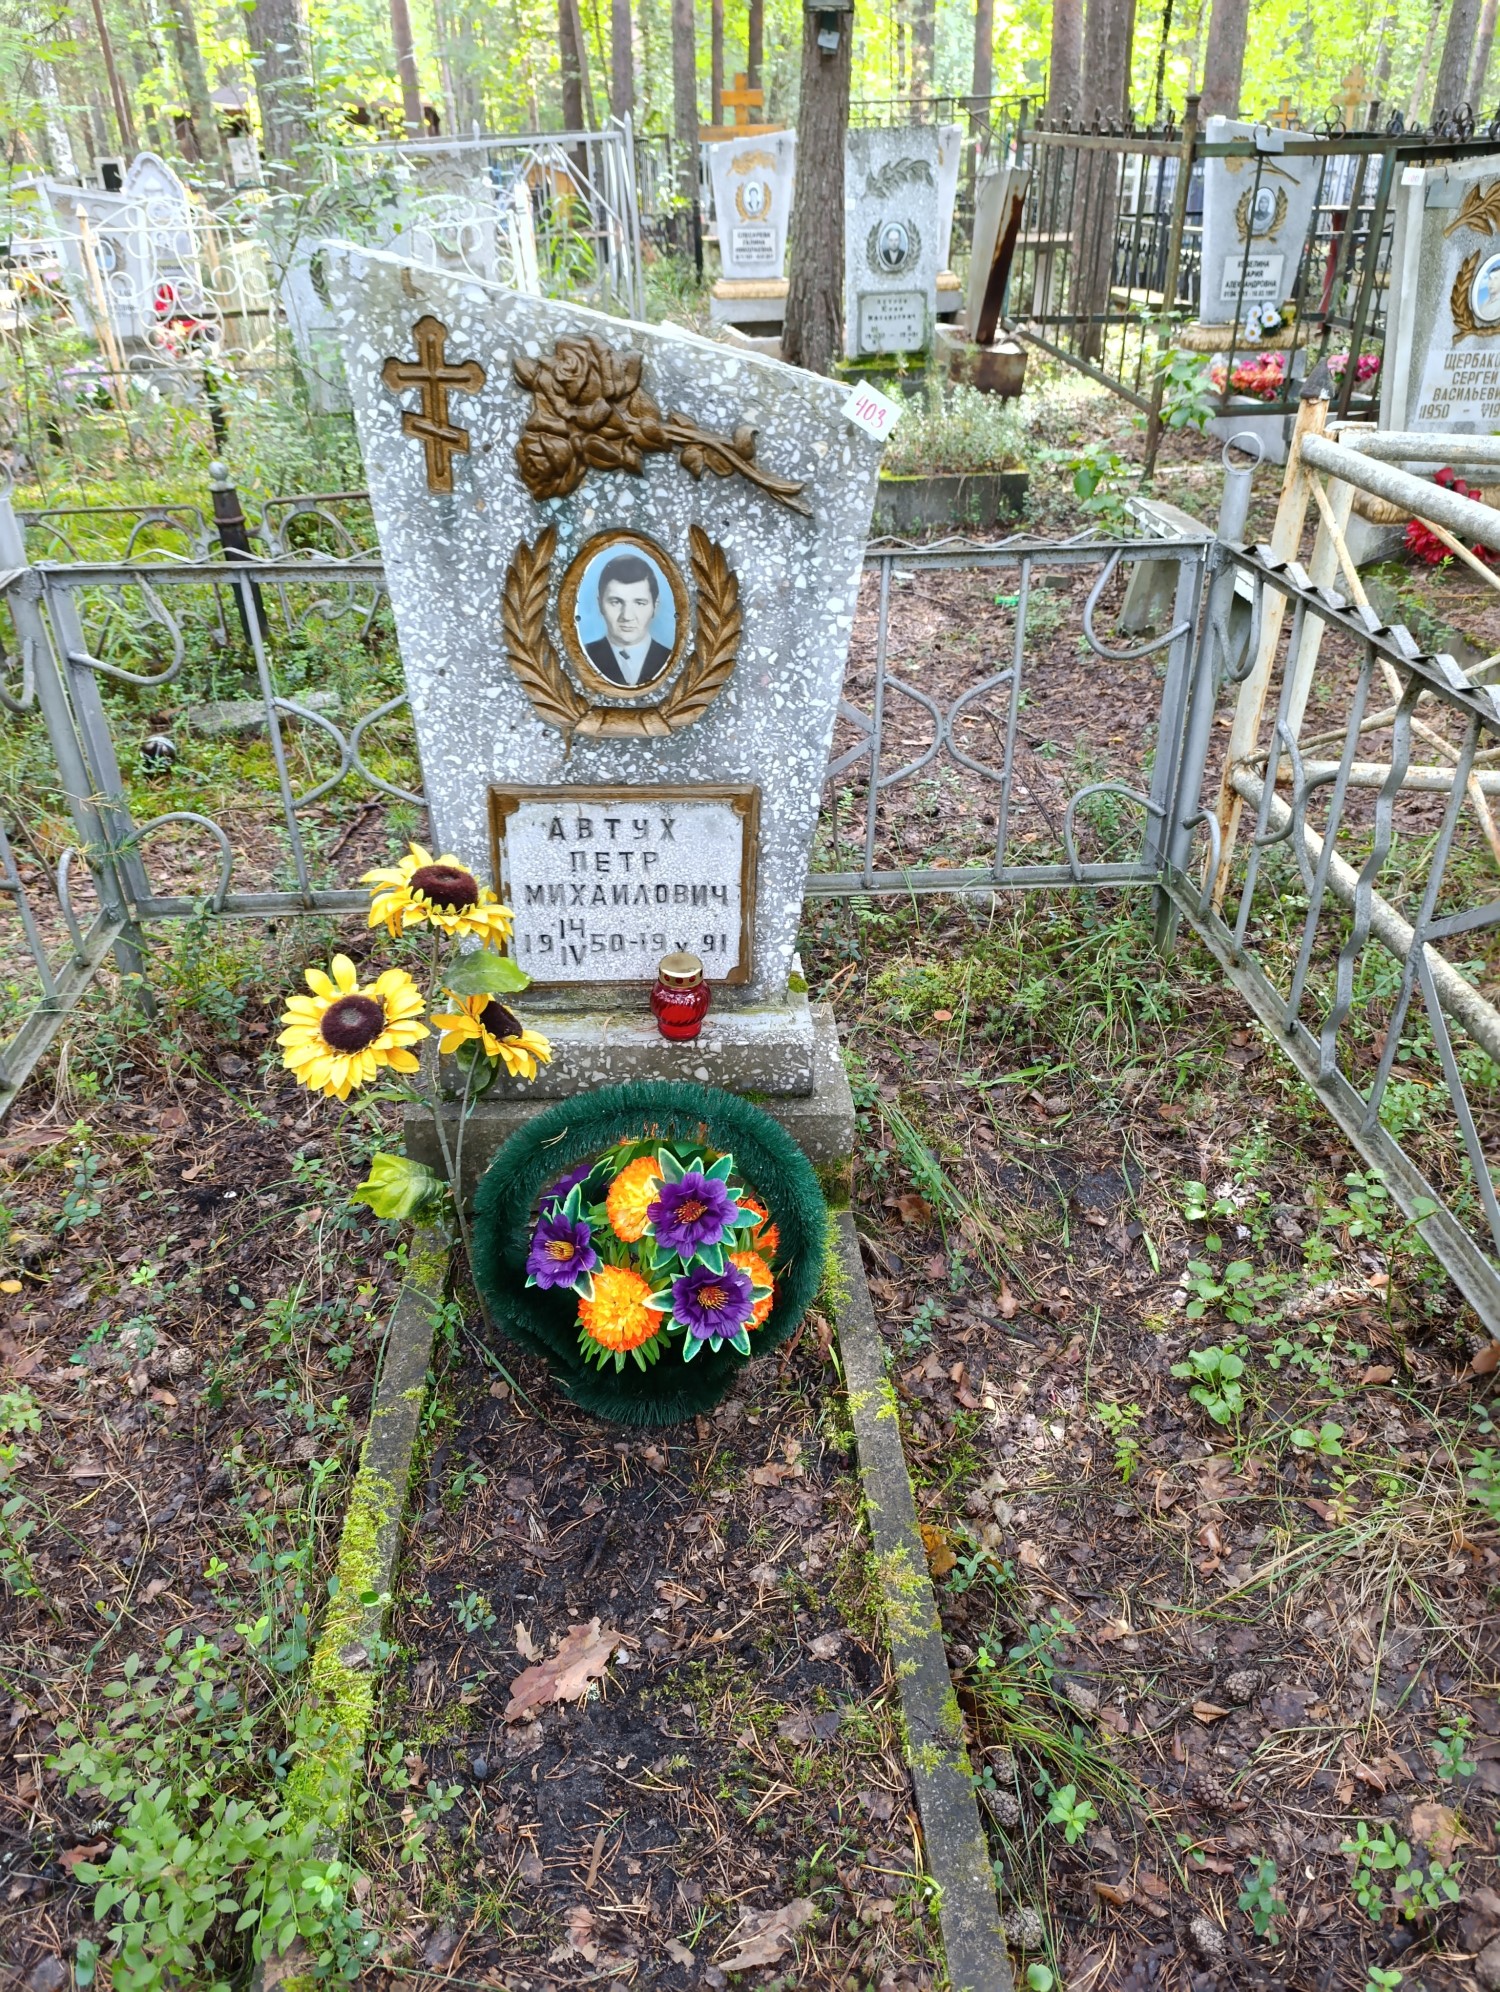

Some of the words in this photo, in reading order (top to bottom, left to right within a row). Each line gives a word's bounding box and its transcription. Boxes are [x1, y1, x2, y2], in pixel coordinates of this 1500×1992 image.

[1225, 280, 1277, 288] АЛЕКАНДРОВНА
[856, 394, 887, 429] 403
[550, 817, 676, 841] АВТУХ
[571, 851, 658, 873] ПЕТР
